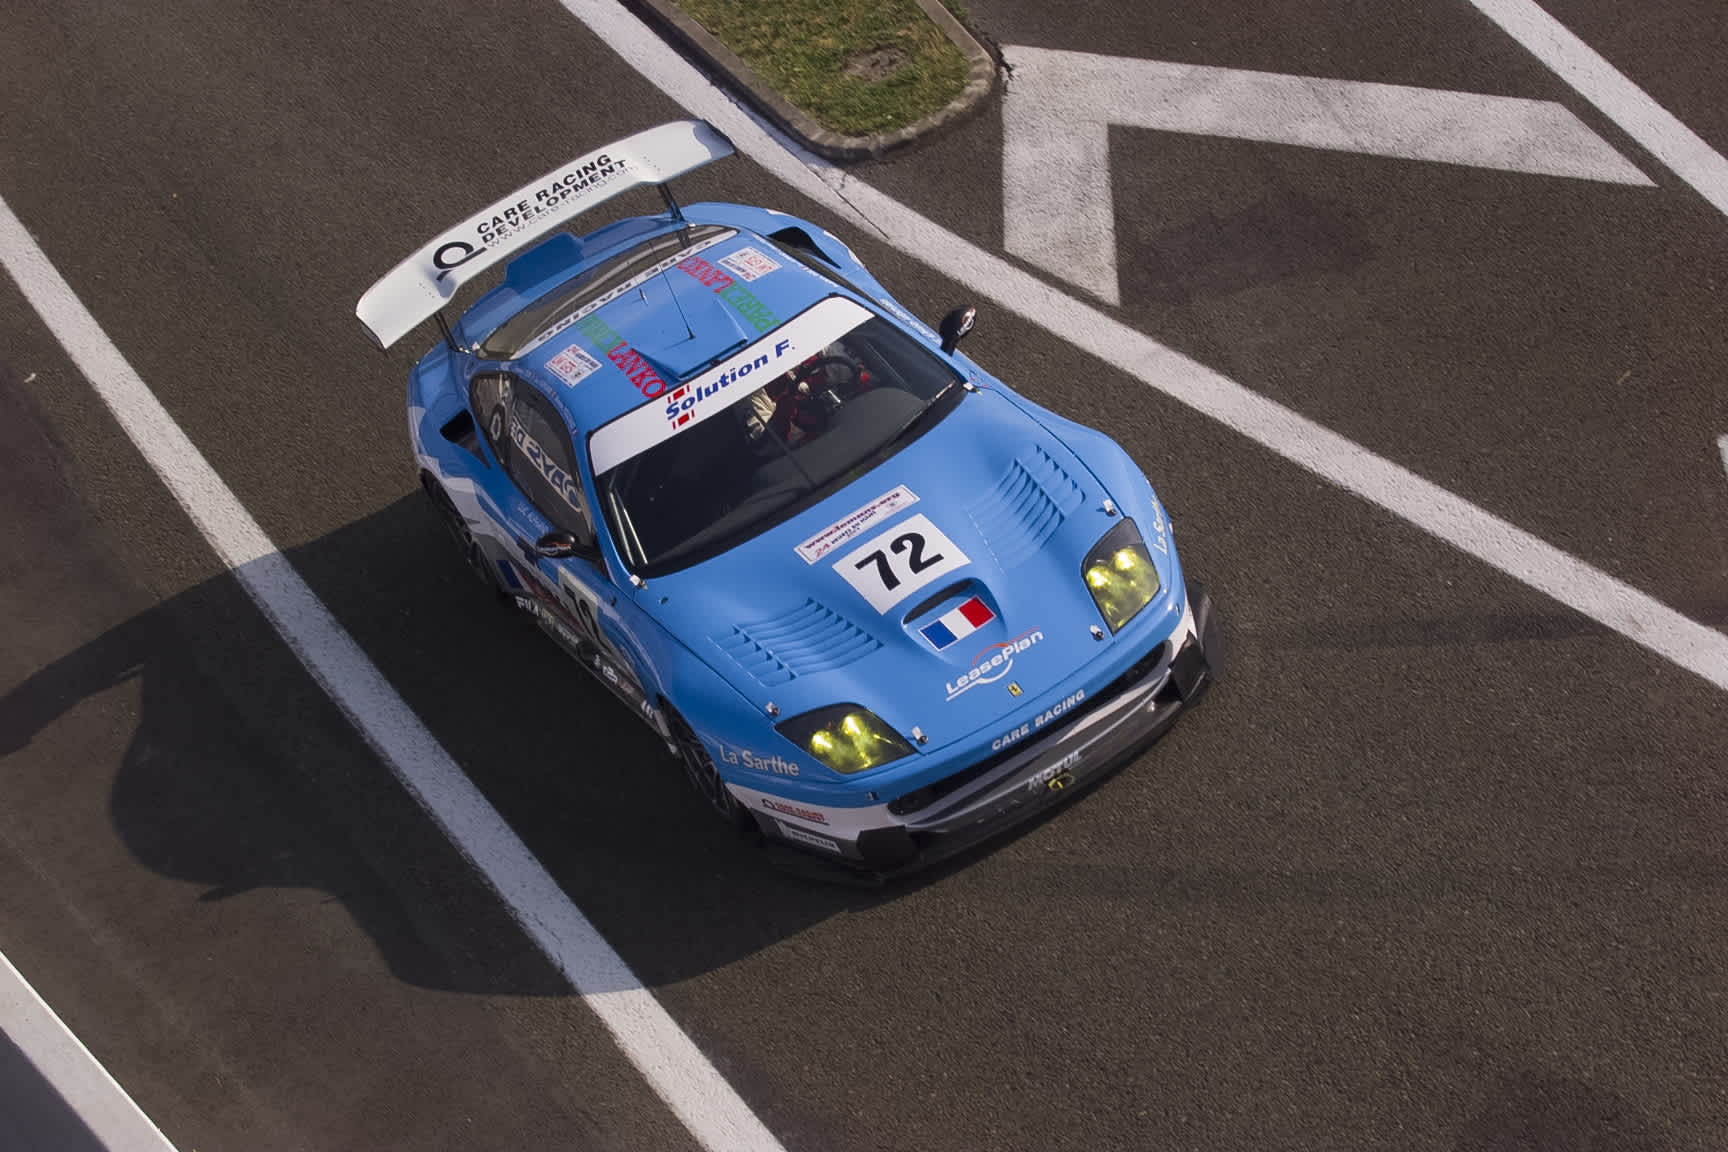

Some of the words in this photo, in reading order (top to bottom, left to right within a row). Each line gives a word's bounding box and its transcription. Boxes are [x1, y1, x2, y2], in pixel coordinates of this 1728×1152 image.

[477, 199, 529, 235] CARE
[535, 154, 612, 201] RACING
[482, 159, 627, 244] DEVELOPMENT
[606, 340, 667, 399] LANKO
[664, 351, 770, 421] Solution
[775, 339, 796, 360] F.
[854, 532, 945, 592] 72
[946, 629, 1045, 695] LeasePlan
[992, 722, 1030, 751] CARE
[1034, 688, 1086, 728] RACING
[719, 745, 738, 765] La
[743, 749, 800, 777] Sarthe
